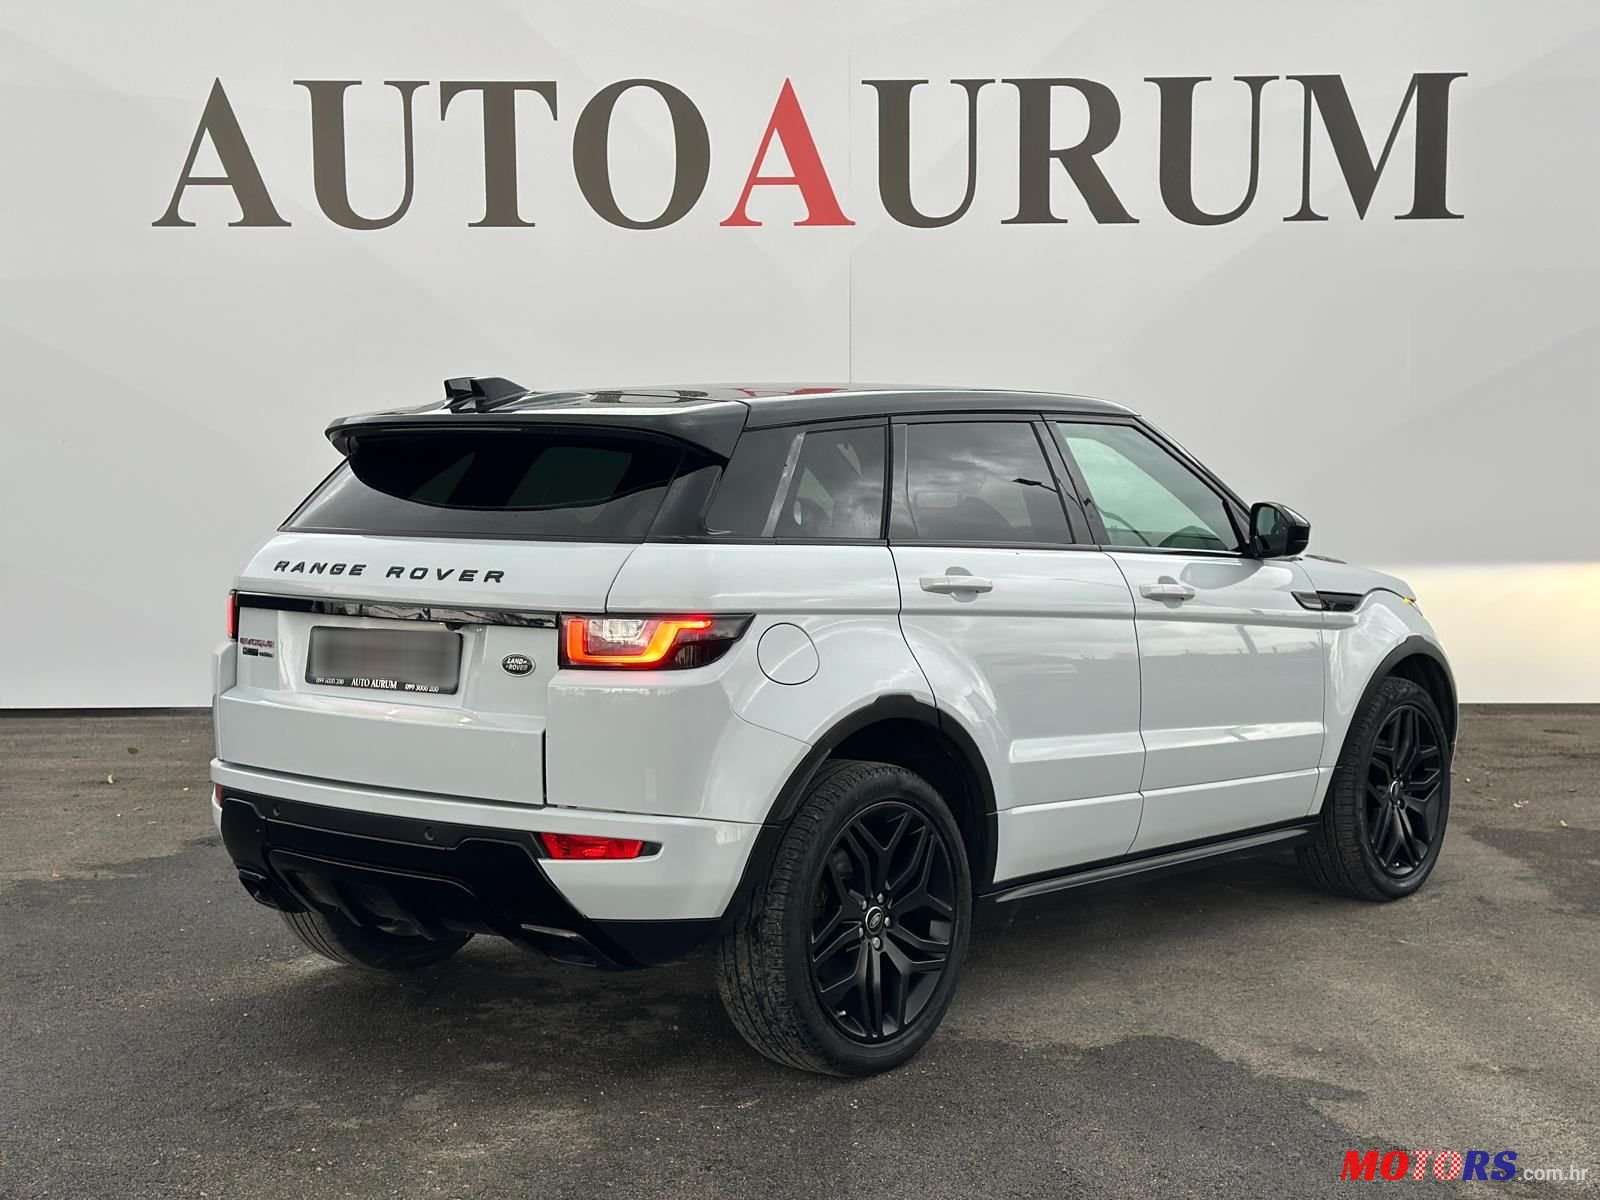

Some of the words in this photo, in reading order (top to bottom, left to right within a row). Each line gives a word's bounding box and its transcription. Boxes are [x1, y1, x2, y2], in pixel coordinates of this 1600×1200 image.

[152, 73, 1468, 230] AUTOAURUM
[273, 560, 367, 576] RANGE
[386, 566, 505, 584] ROVER
[351, 678, 370, 687] AUTO
[370, 679, 398, 689] AURUM
